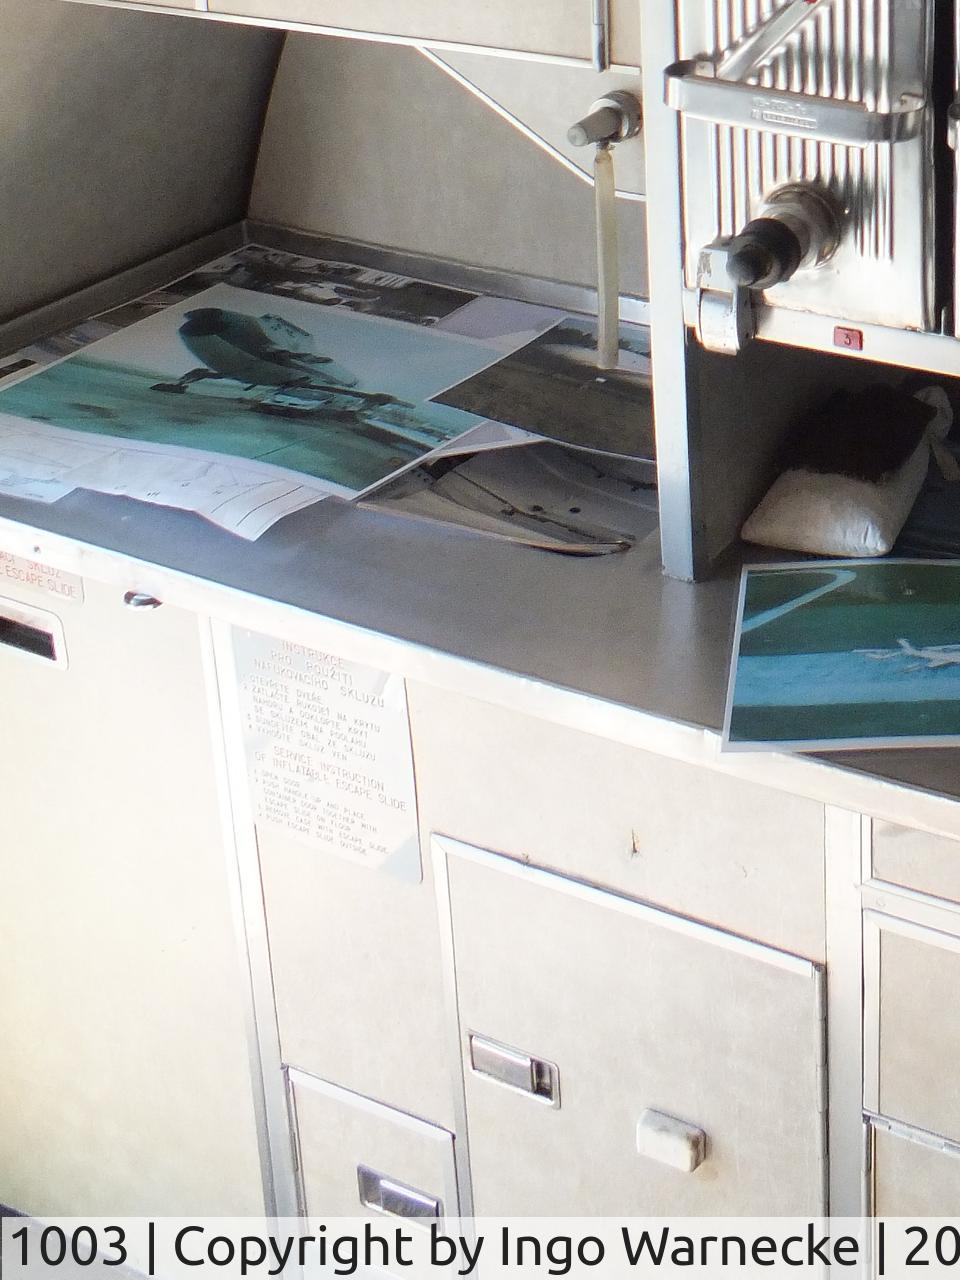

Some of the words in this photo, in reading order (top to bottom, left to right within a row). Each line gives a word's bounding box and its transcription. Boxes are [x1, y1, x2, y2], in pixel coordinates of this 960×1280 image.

[5, 565, 44, 587] ESCAPE
[48, 579, 78, 600] SLIDE
[281, 640, 344, 669] INSTRUKCE
[340, 686, 385, 708] SKLUZU
[255, 751, 266, 762] OF
[336, 778, 372, 801] ESCAPE
[378, 792, 407, 812] SLIDE
[273, 745, 312, 767] SERVICE
[320, 762, 384, 792] INSTRUCTION
